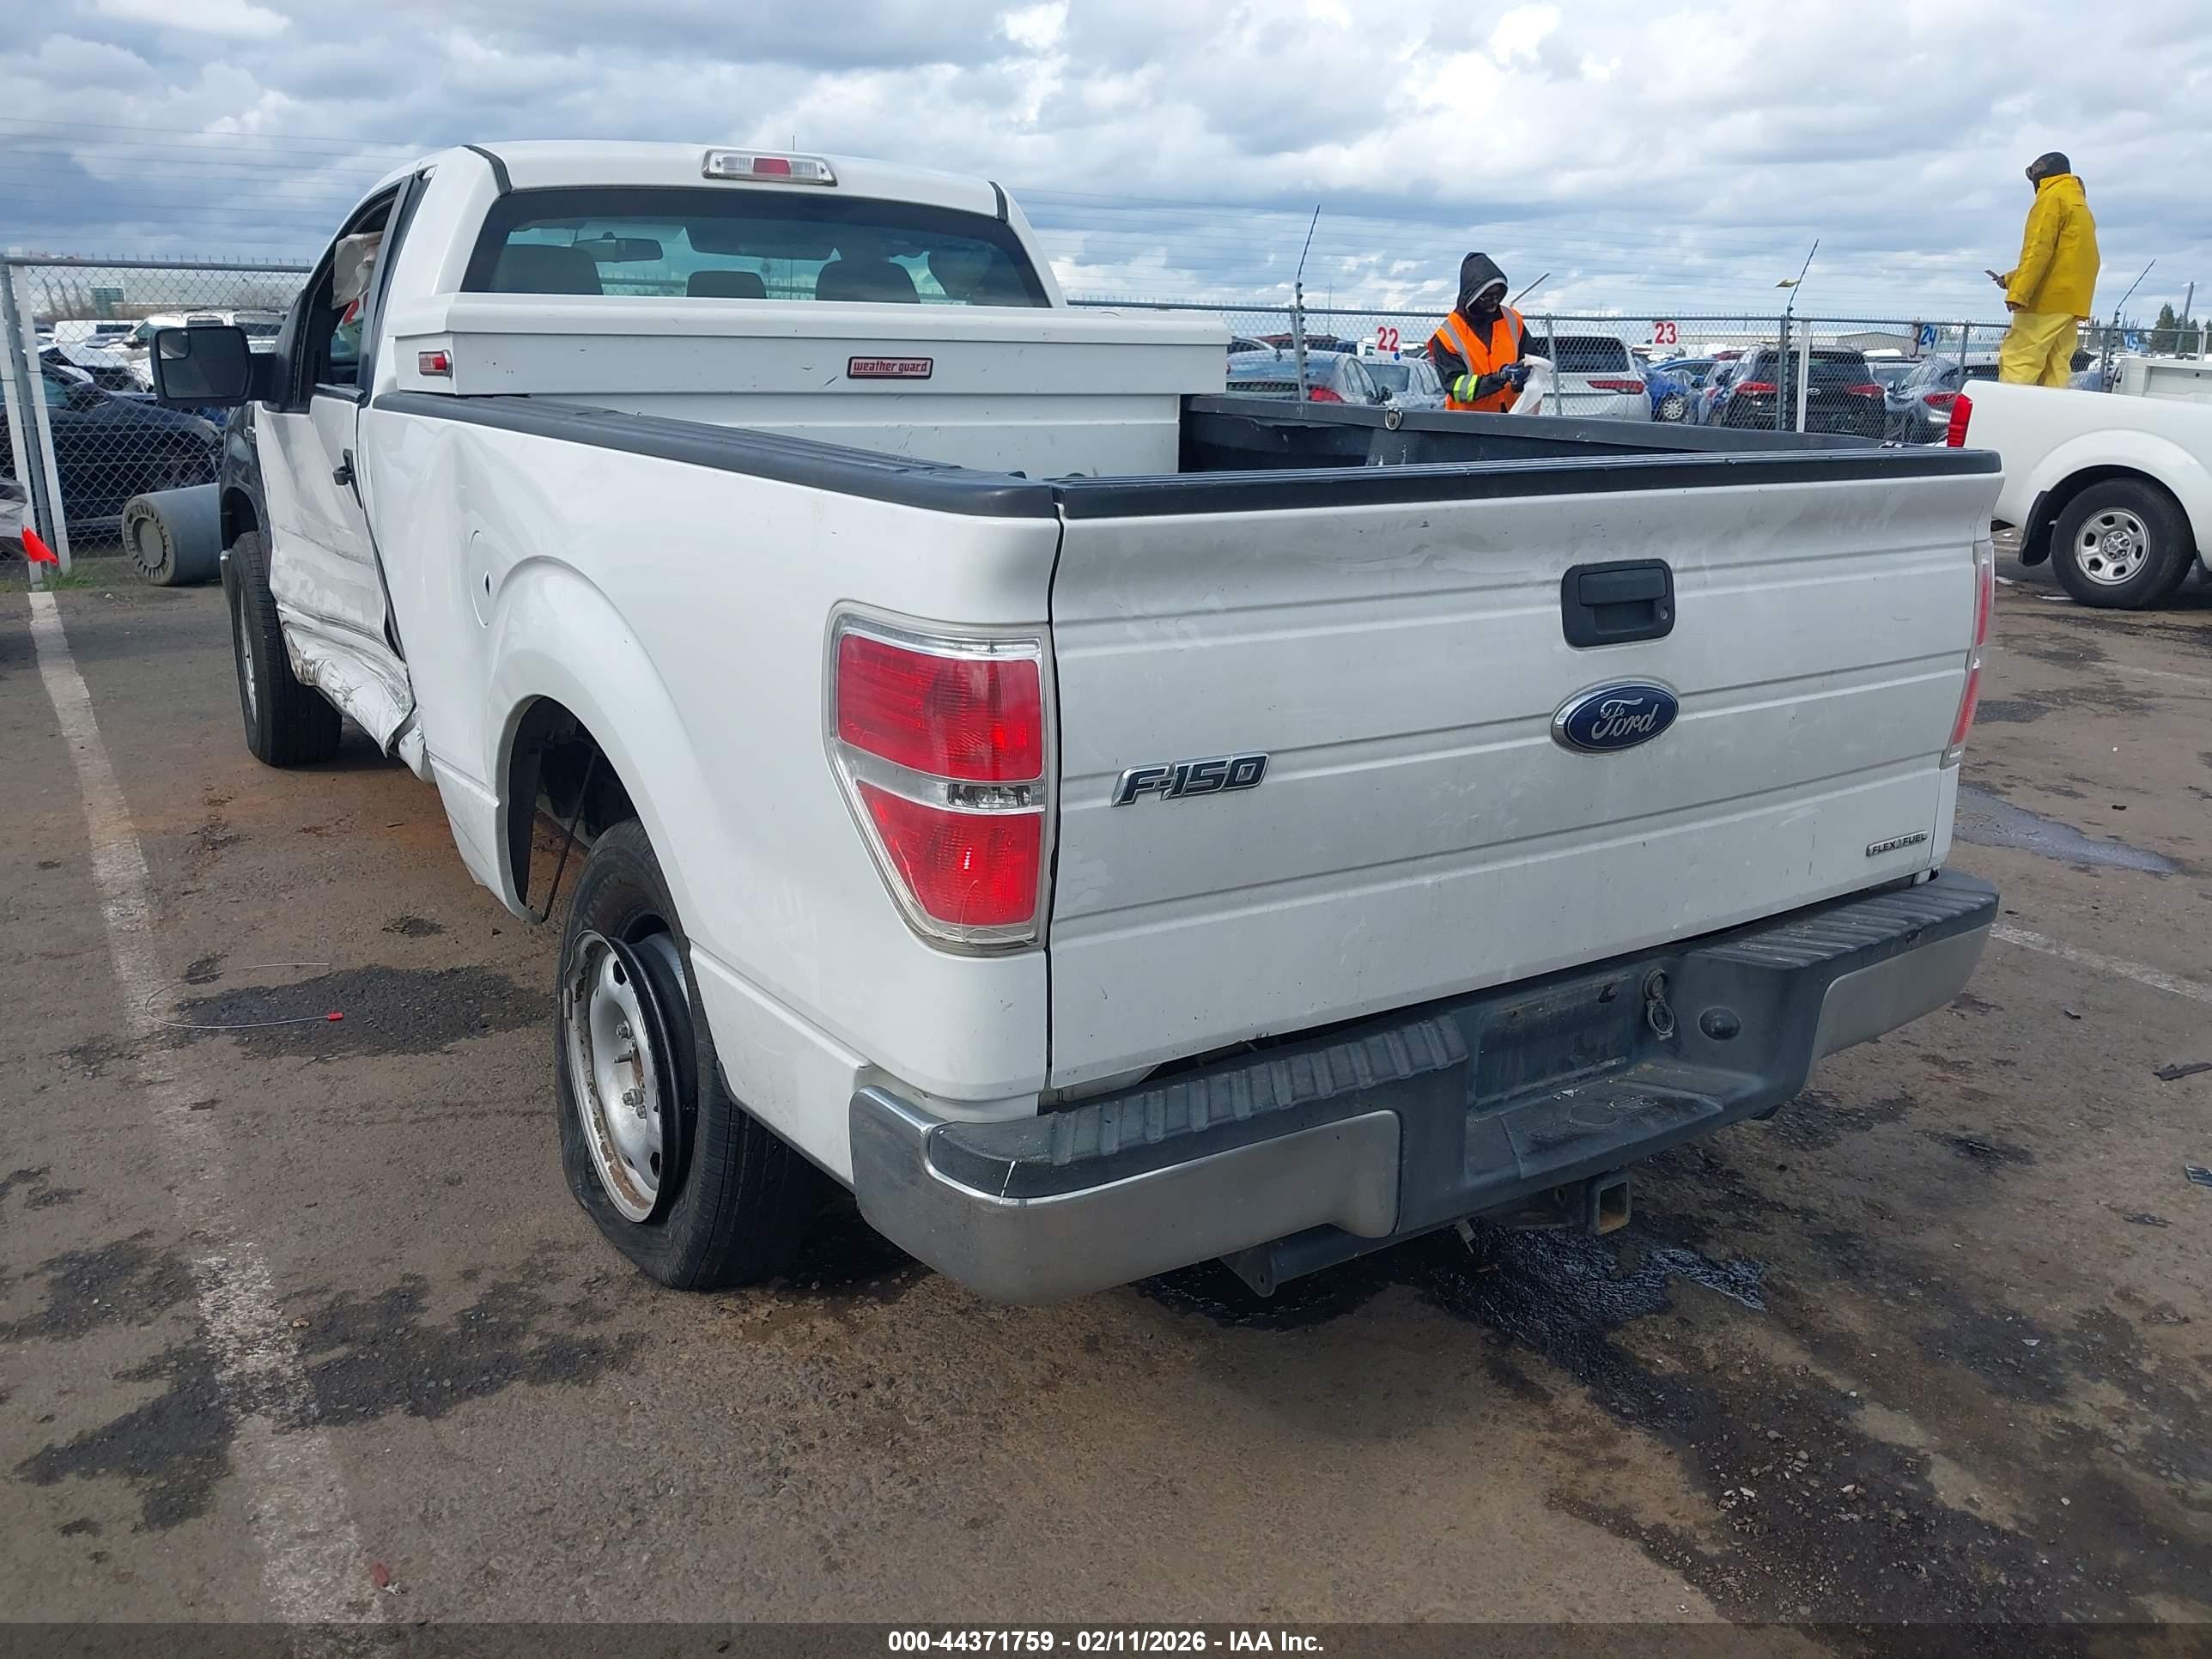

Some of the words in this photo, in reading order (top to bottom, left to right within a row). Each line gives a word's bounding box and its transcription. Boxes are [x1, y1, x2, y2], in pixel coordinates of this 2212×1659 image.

[1377, 326, 1399, 352] 22
[1655, 322, 1677, 344] 23
[1920, 325, 1938, 350] 24
[853, 361, 896, 372] weather
[898, 361, 928, 374] guard
[1591, 697, 1659, 740] Ford
[1111, 750, 1270, 807] F-150
[1902, 832, 1927, 846] FUEL
